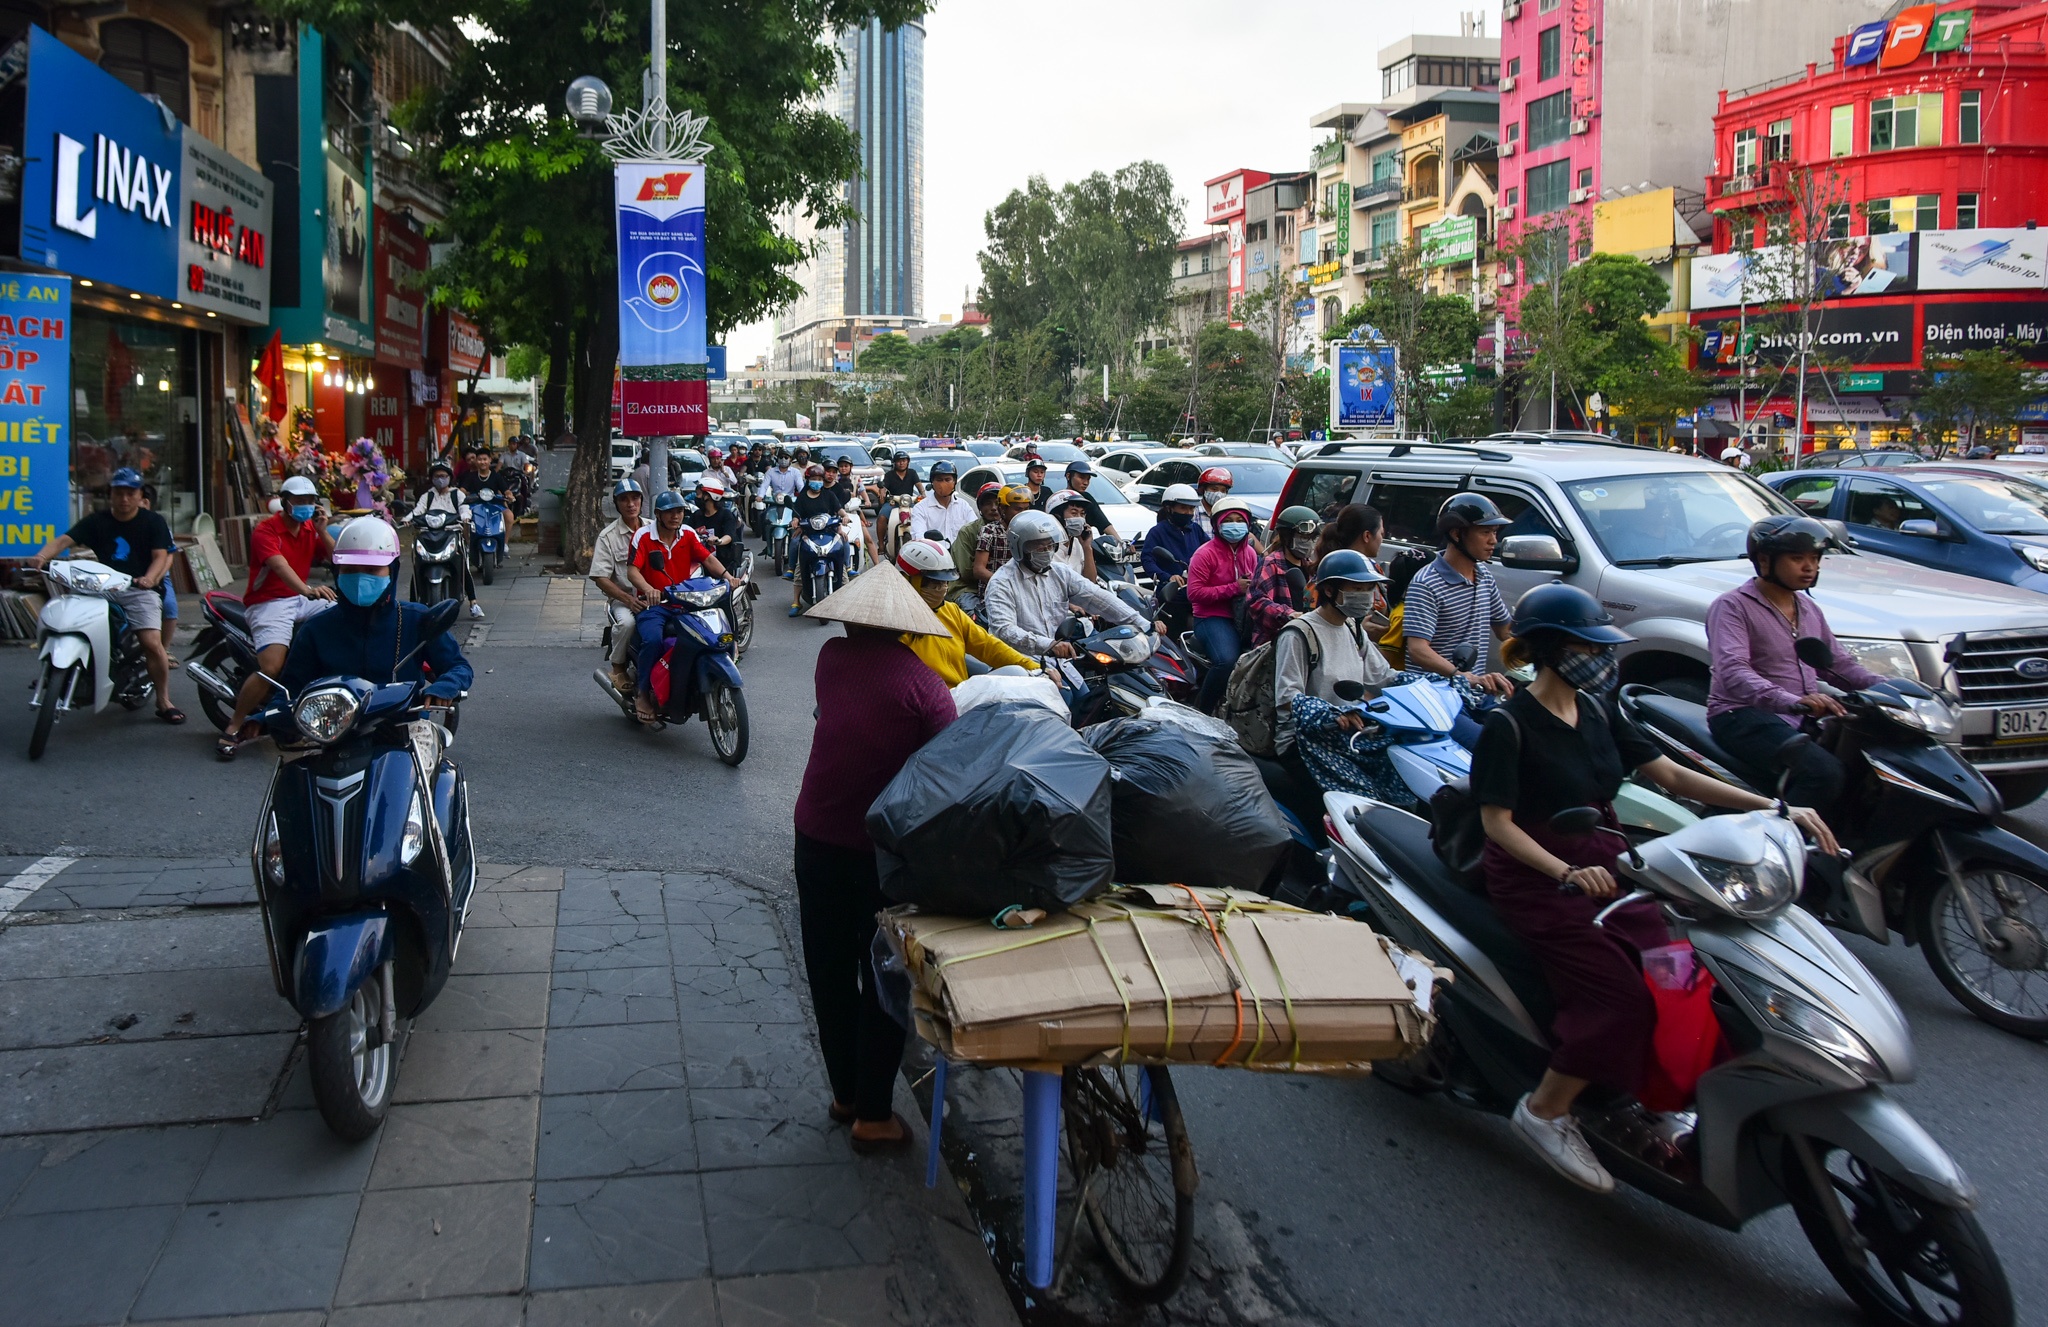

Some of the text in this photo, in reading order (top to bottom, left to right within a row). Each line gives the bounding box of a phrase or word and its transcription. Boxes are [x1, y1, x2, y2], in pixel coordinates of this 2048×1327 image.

[1850, 19, 1965, 57] FPT
[97, 133, 172, 228] INAX
[1340, 184, 1349, 250] EVERON
[193, 201, 265, 269] HUỆ AN
[27, 286, 59, 301] AN
[1926, 324, 1963, 344] Điện
[1968, 324, 2004, 344] thoại
[2017, 322, 2043, 344] Máy
[0, 378, 46, 406] ÁT
[371, 392, 398, 416] RÈM
[640, 404, 704, 414] AGRIBANK
[376, 428, 393, 446] AN
[2026, 662, 2048, 674] Ford
